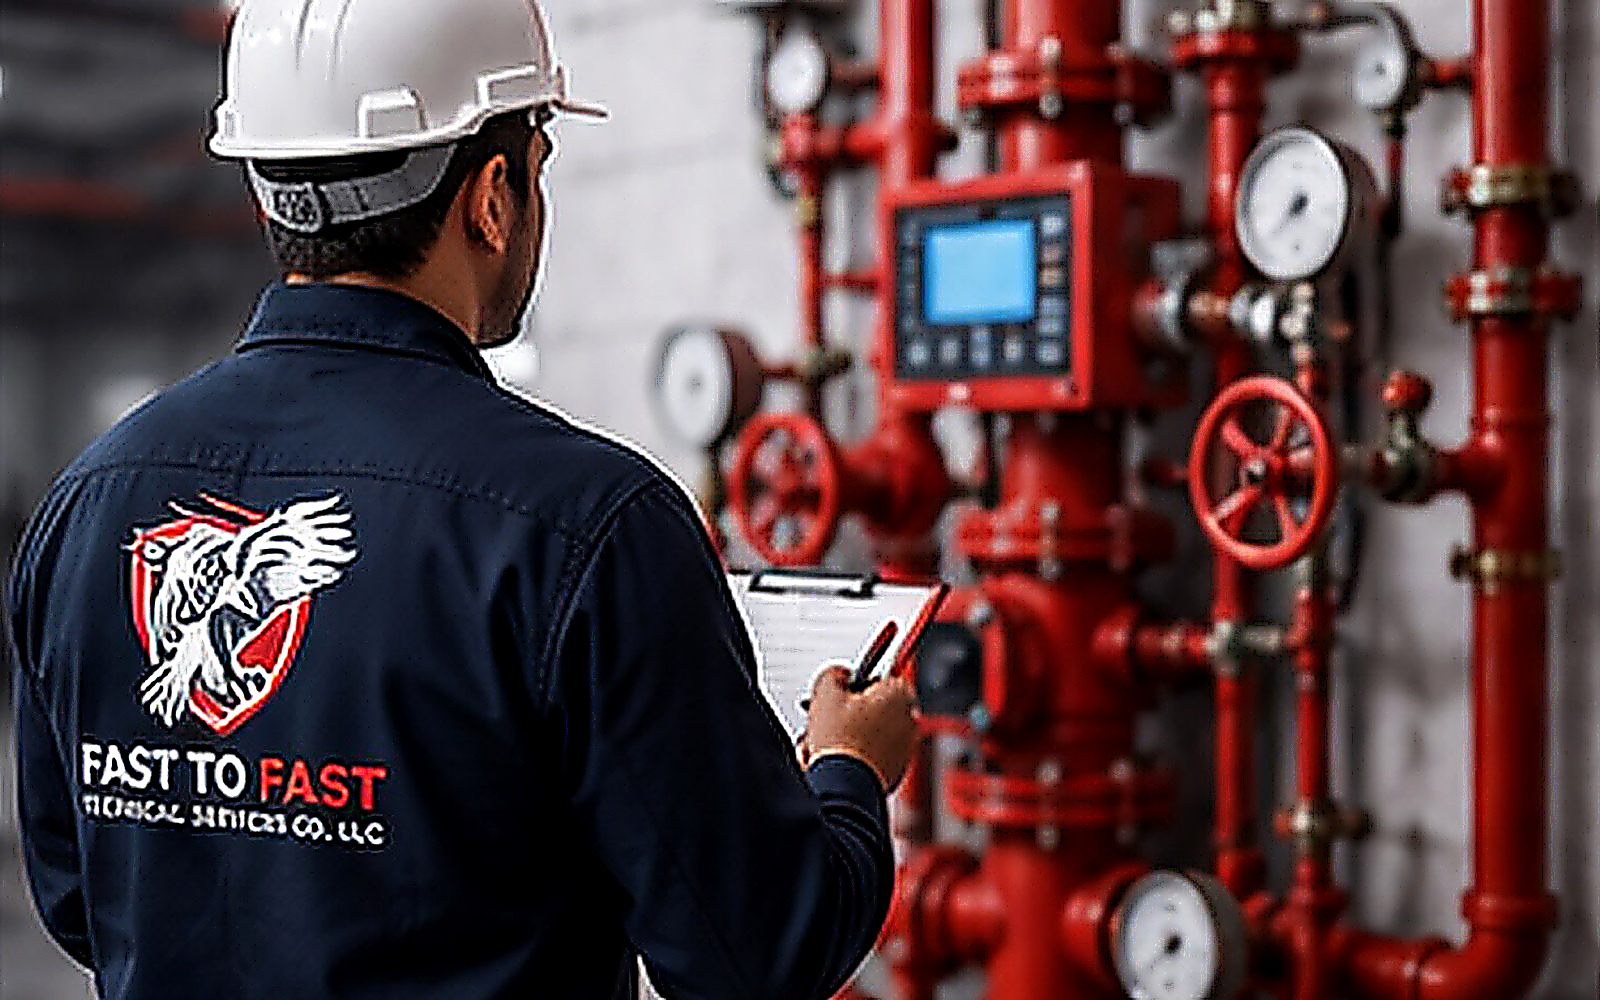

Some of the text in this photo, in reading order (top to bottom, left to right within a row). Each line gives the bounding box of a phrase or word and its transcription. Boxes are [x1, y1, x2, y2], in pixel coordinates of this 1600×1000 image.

[81, 743, 387, 810] FAST TO FAST
[291, 813, 333, 842] CO.
[337, 821, 385, 846] LLC
